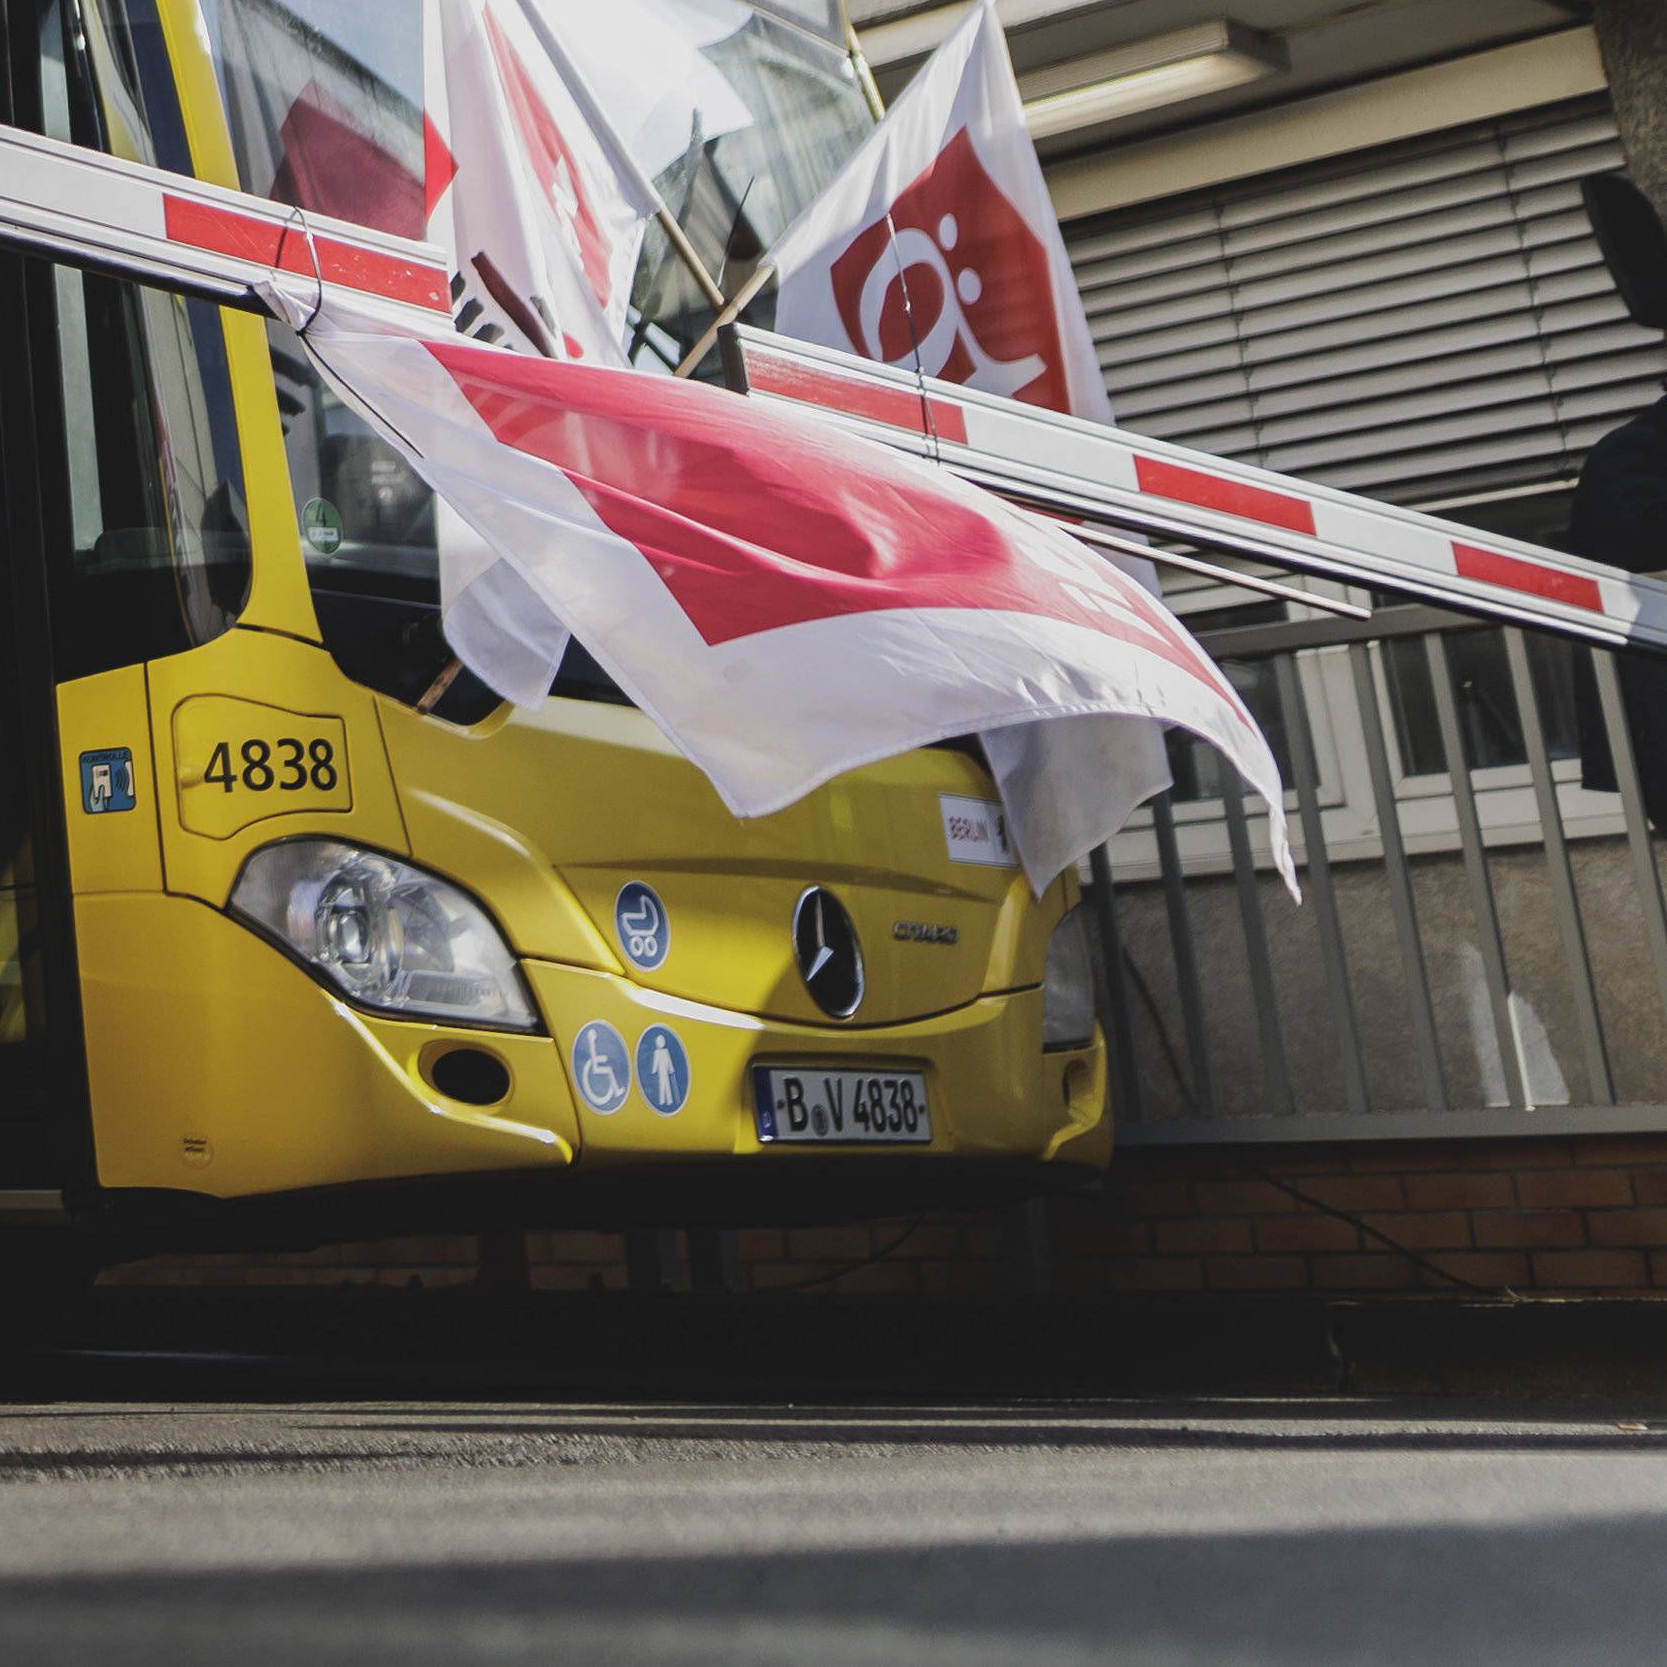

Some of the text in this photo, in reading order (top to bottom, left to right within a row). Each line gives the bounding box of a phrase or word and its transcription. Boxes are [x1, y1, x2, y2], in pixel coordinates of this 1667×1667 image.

[203, 737, 338, 794] 4838
[949, 816, 988, 842] BERLIN
[783, 1076, 918, 1133] B V 4838
